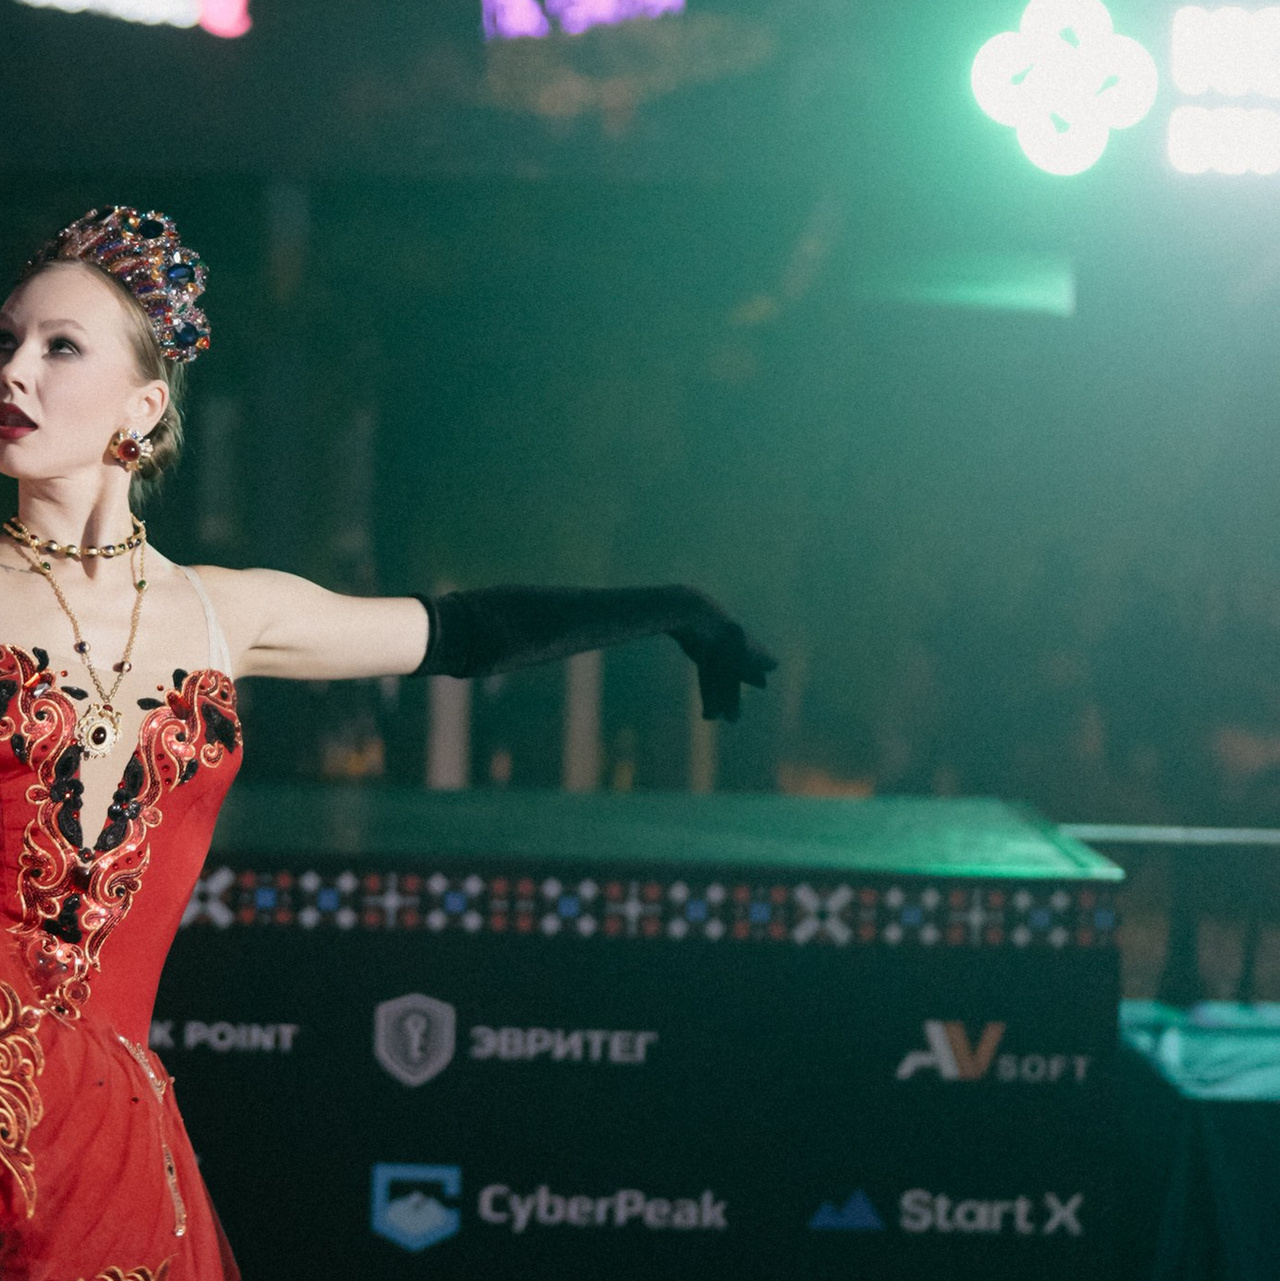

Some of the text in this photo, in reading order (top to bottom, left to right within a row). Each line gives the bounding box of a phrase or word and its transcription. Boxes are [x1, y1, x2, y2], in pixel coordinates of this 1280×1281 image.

[184, 1021, 300, 1052] POINT
[470, 1025, 658, 1064] ЭВРИТЕГ
[477, 1183, 729, 1233] CyberPeak
[900, 1188, 1084, 1235] Start X
